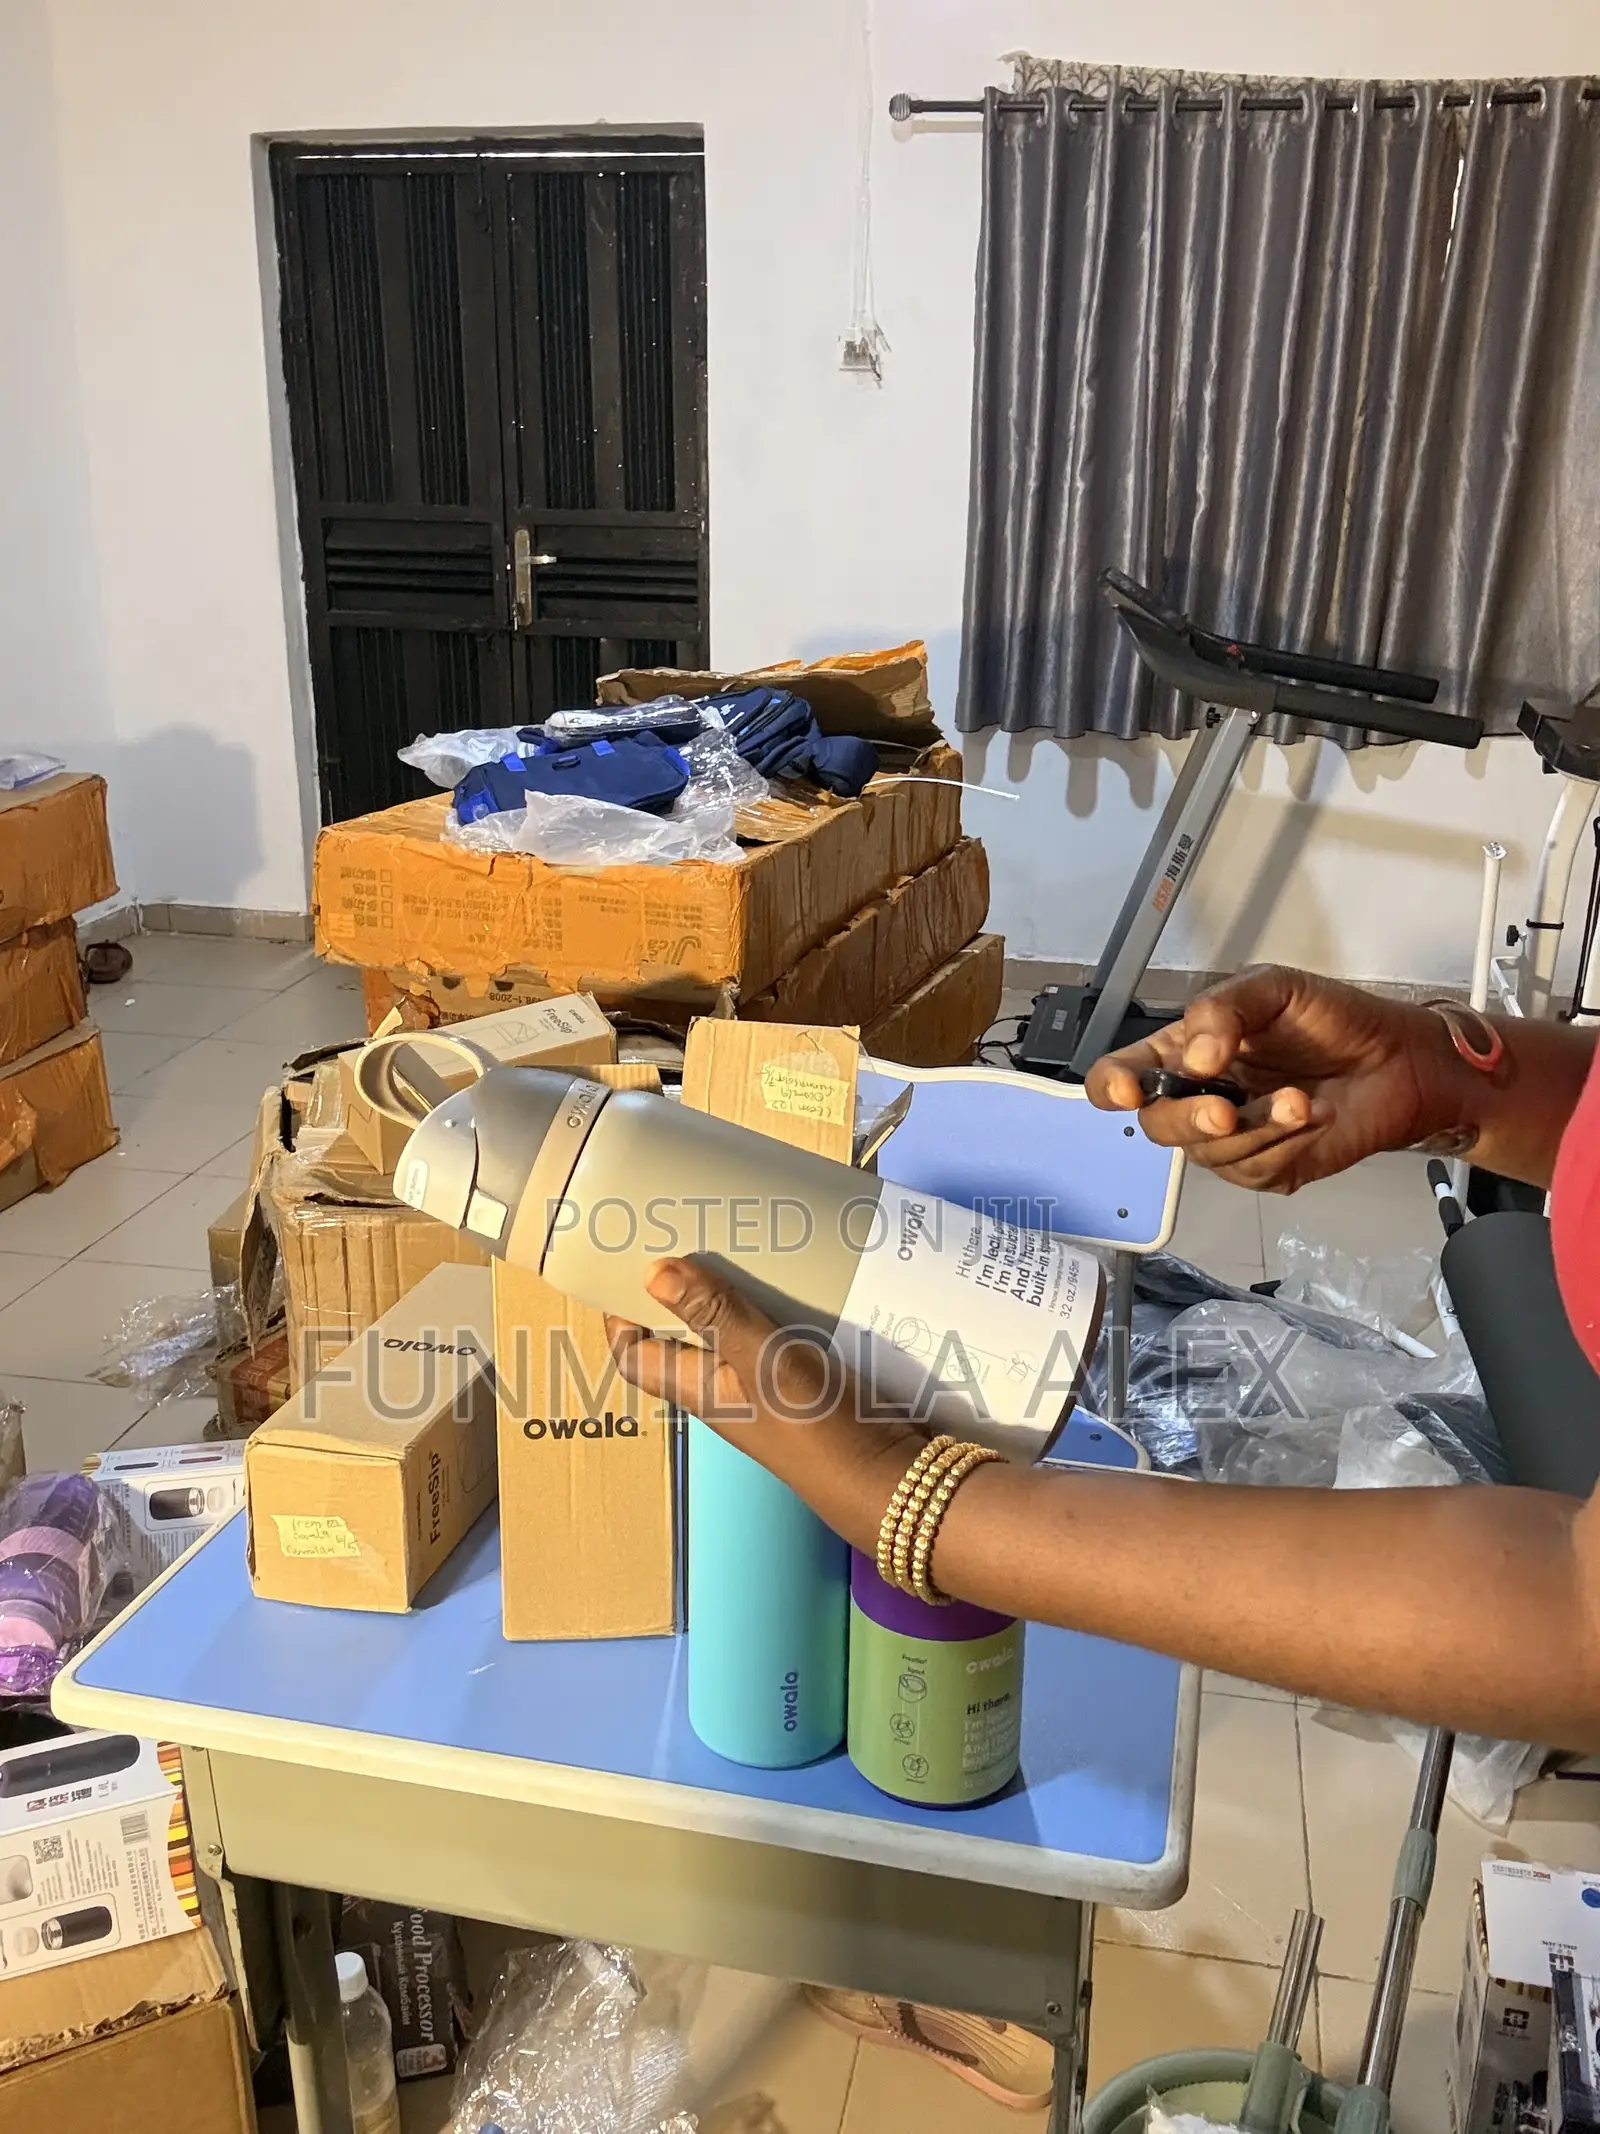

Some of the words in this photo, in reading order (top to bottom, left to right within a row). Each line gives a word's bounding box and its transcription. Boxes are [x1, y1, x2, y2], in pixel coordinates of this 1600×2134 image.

[897, 1202, 926, 1261] owala
[982, 1233, 1001, 1262] leak
[975, 1263, 996, 1289] I'm
[992, 1270, 1012, 1294] I'm
[1009, 1264, 1031, 1301] And
[1026, 1255, 1051, 1308] built-in
[1060, 1303, 1073, 1319] 32
[383, 1338, 477, 1356] owala
[523, 1411, 639, 1440] owala
[428, 1450, 442, 1545] FreeSip
[780, 1671, 798, 1732] owala
[408, 1907, 433, 1947] ood
[413, 1951, 435, 2042] Processor
